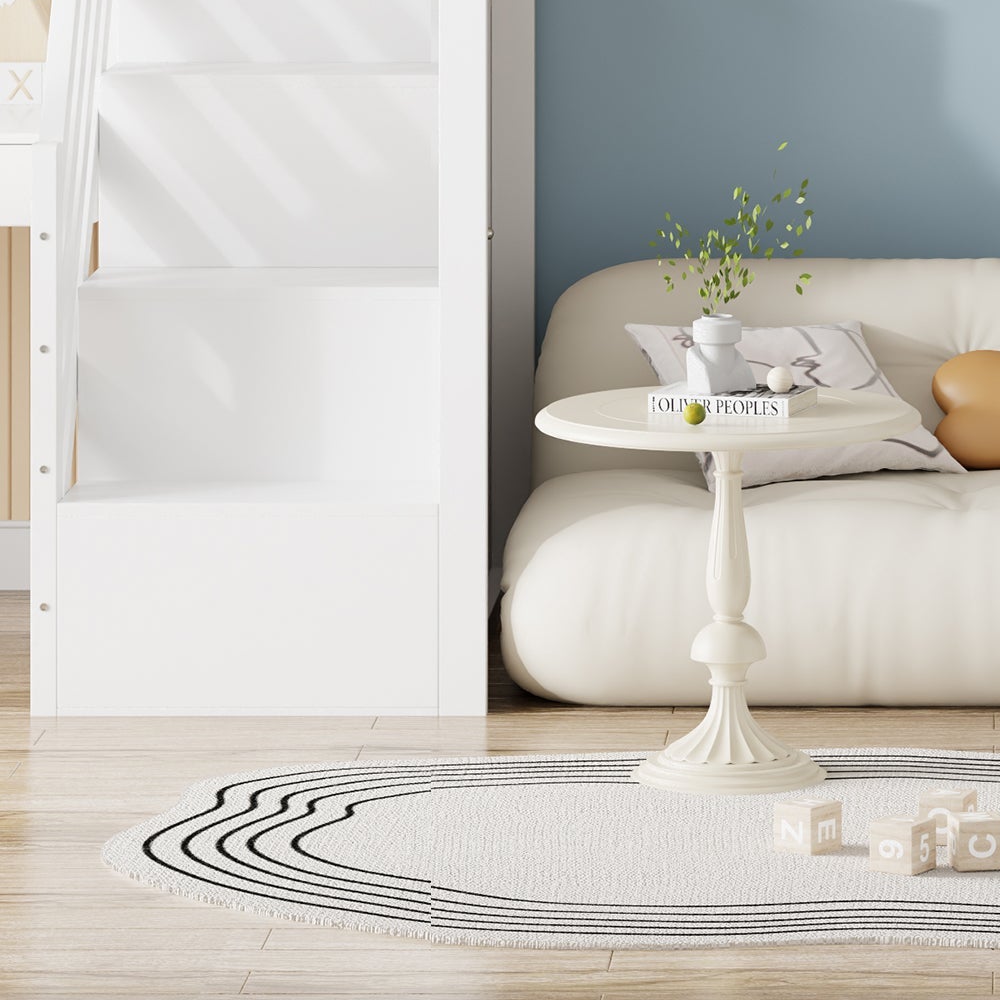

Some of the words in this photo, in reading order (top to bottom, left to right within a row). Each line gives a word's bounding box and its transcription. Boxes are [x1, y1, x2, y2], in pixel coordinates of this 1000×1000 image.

[658, 397, 711, 414] OLIR
[716, 400, 779, 417] PEOPLES
[818, 818, 836, 844] E
[920, 833, 930, 862] 5
[968, 833, 997, 859] C
